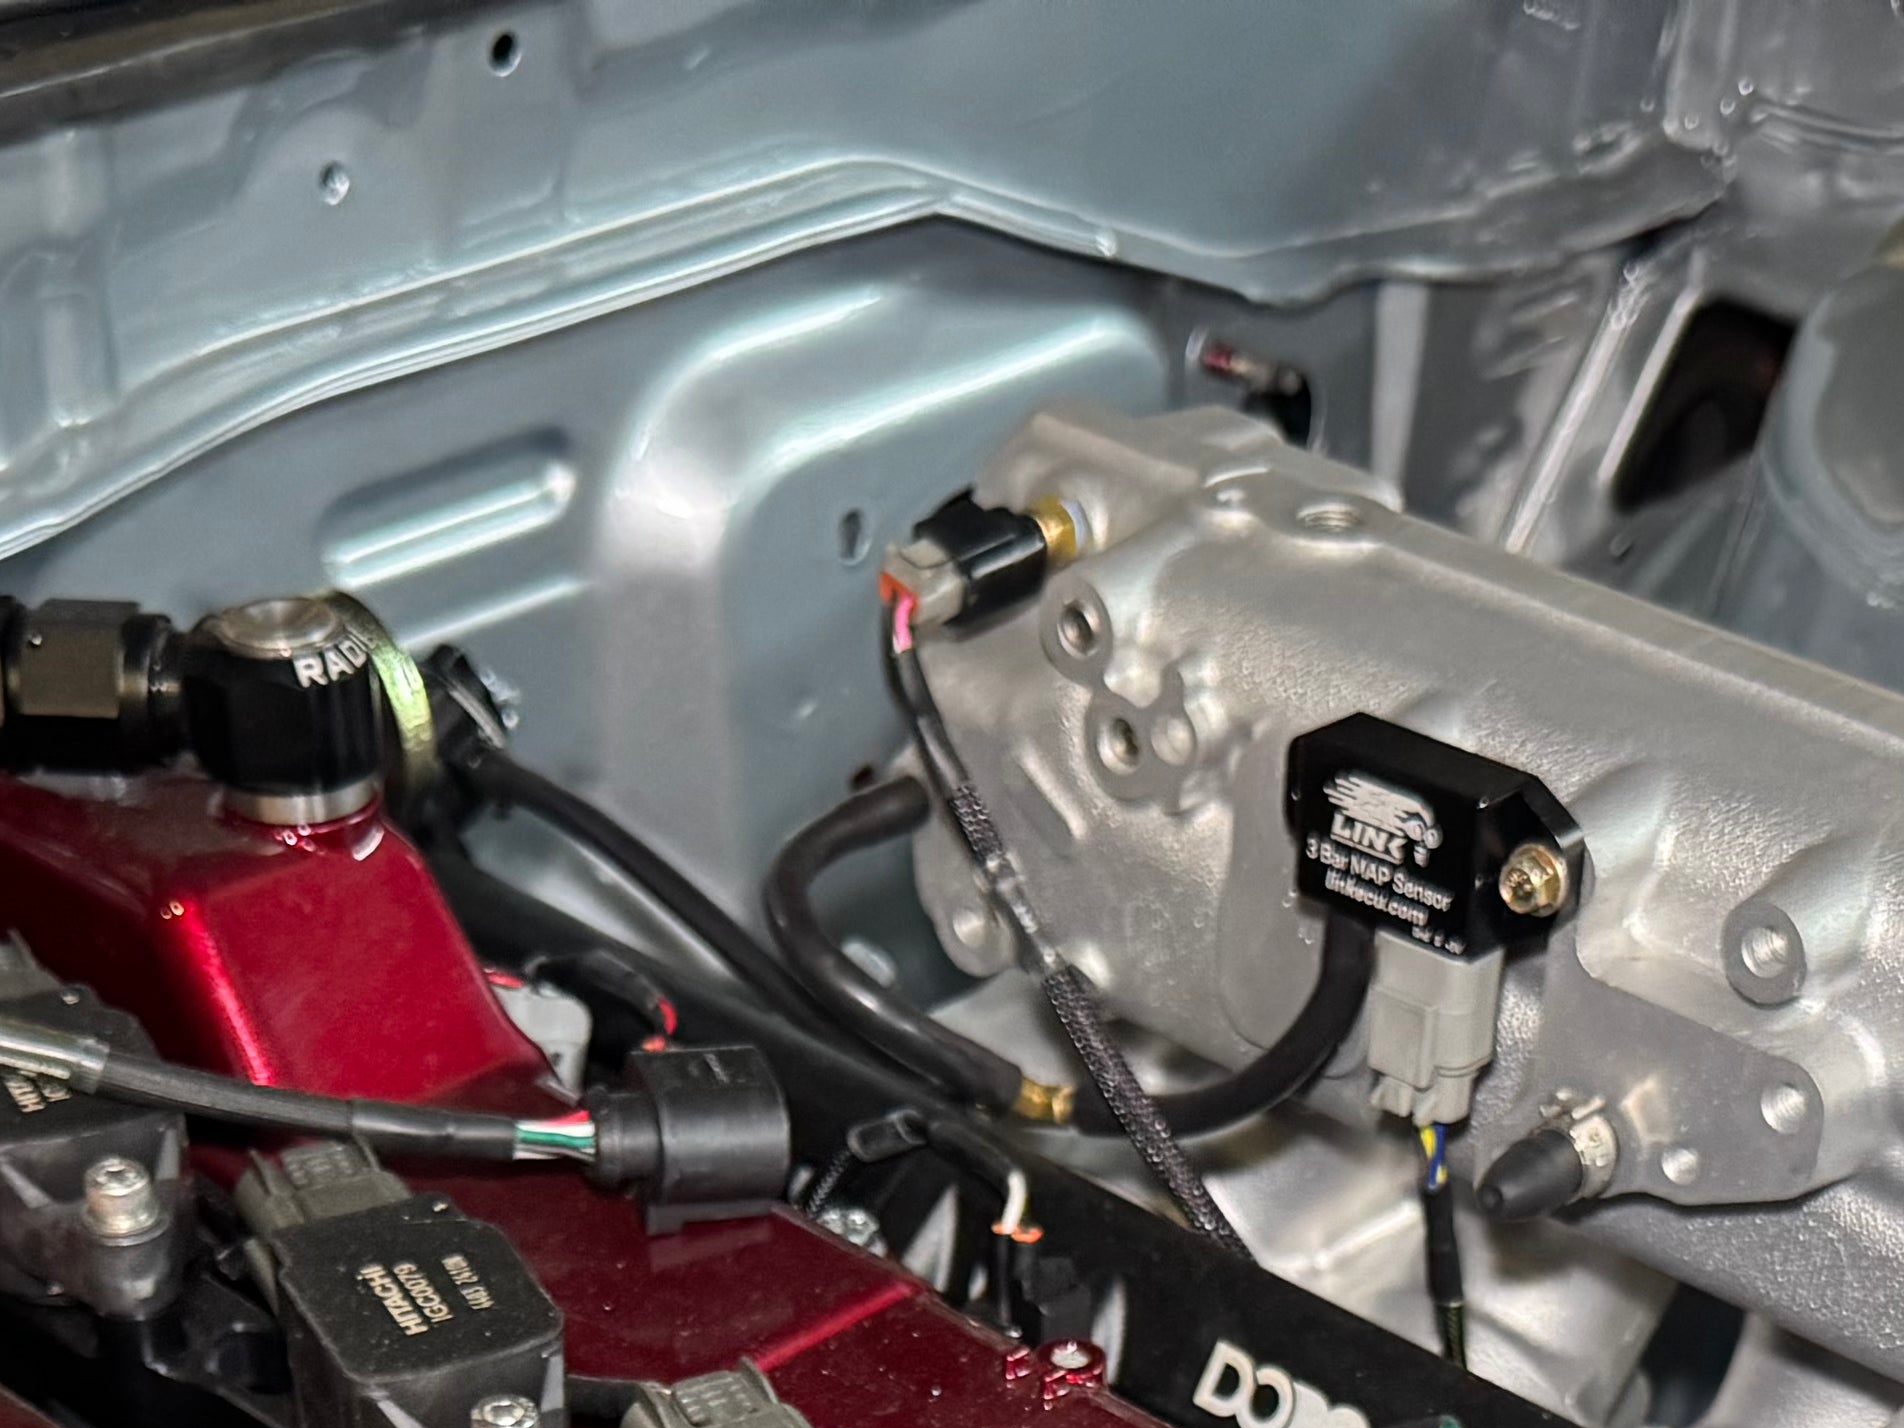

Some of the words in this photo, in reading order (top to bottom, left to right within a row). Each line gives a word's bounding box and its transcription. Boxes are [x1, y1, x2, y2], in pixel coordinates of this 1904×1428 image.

[1305, 836, 1319, 860] 3
[1319, 842, 1349, 871] Bar
[1350, 852, 1392, 886] MAP
[1392, 869, 1454, 912] Sensor
[359, 1264, 429, 1336] HITACHI
[393, 1262, 454, 1323] IGC0079
